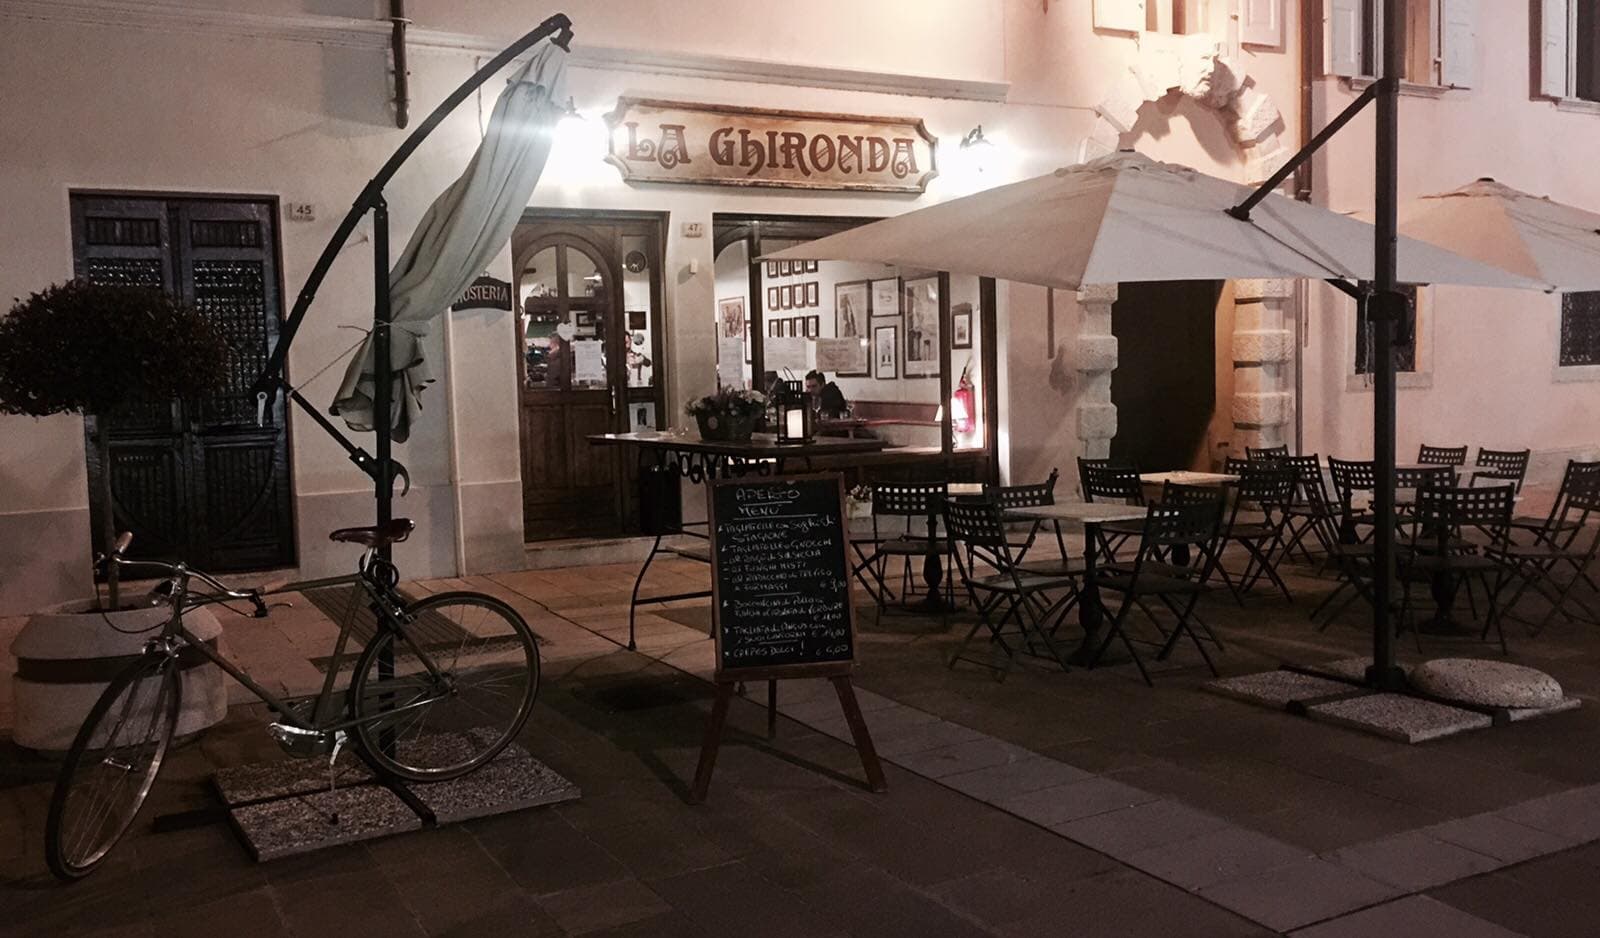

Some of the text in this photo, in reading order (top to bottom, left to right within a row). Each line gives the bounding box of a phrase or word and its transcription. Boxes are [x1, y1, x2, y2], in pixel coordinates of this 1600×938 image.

[622, 121, 692, 170] LA
[296, 205, 312, 214] 45
[736, 487, 801, 501] APERTO
